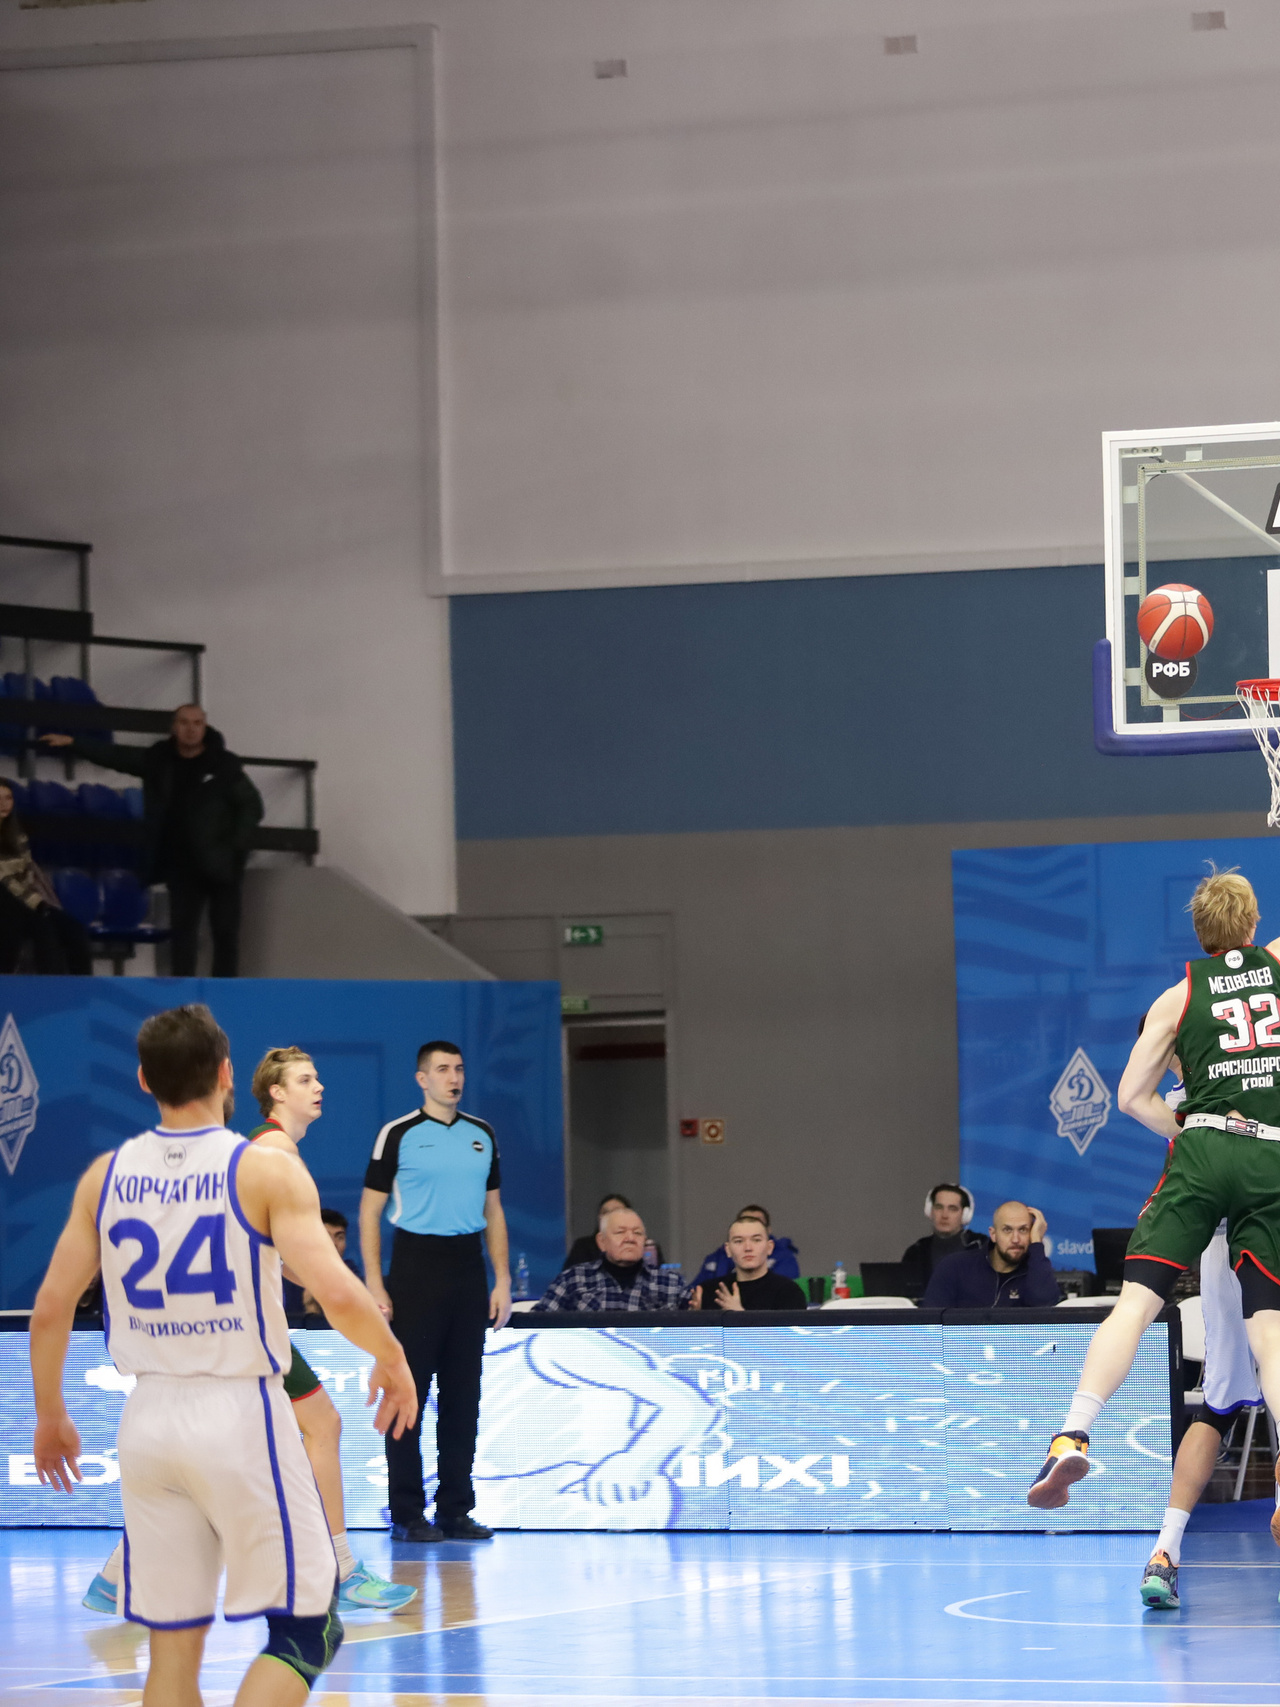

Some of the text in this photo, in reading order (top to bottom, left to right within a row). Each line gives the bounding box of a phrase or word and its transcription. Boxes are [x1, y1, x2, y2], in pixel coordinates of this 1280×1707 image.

[1152, 661, 1190, 678] РФБ
[1208, 966, 1274, 995] МЕДВЕДЕВ
[1241, 1075, 1274, 1092] КРАЙ
[114, 1171, 226, 1205] КОРЧАГИН
[1057, 1239, 1095, 1255] slavd
[108, 1213, 237, 1310] 24
